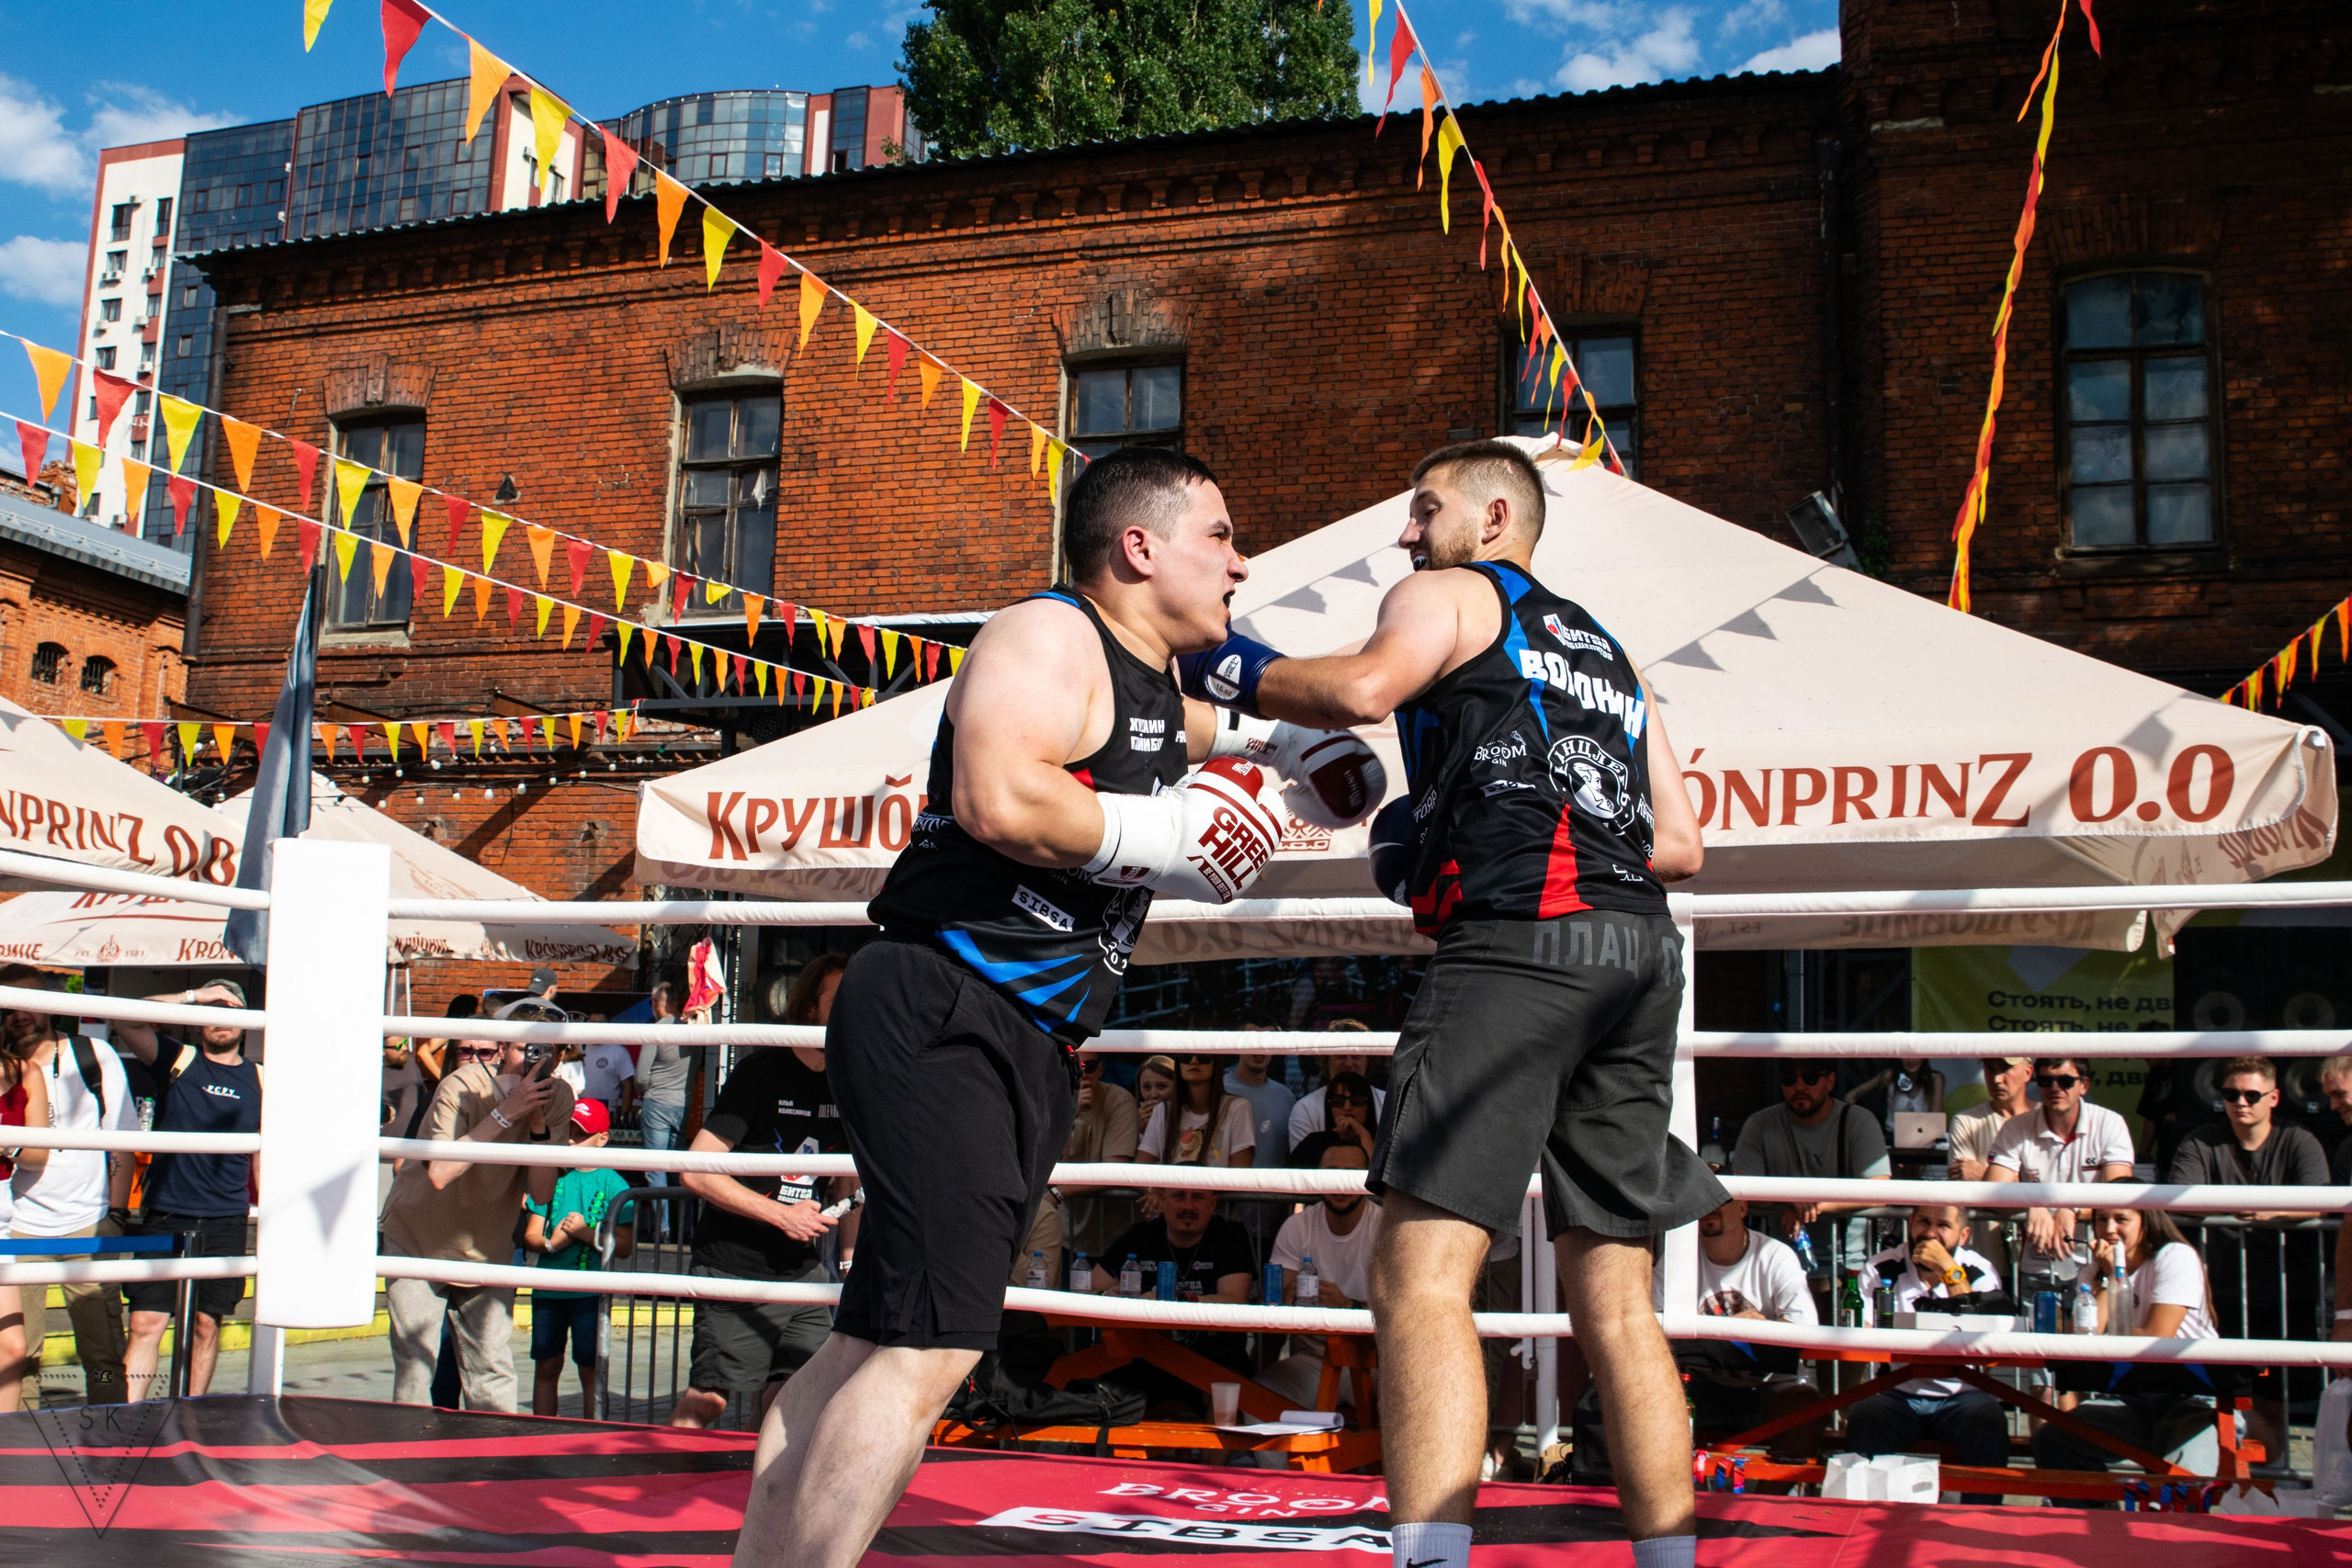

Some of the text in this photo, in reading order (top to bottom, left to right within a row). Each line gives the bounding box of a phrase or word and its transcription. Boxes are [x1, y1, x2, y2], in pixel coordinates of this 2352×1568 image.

[1474, 745, 1528, 761] BROOM
[1491, 758, 1508, 768] GIN
[1213, 807, 1270, 874] GREE
[1197, 823, 1254, 891] HILL
[1203, 866, 1214, 876] BE
[1019, 891, 1068, 930] SIBSA
[1988, 990, 2090, 1012] Стоять,
[2098, 997, 2131, 1010] не
[779, 1184, 813, 1200] БИТВА
[1194, 1504, 1299, 1517] GIN
[1020, 1513, 1394, 1549] SIBSA
